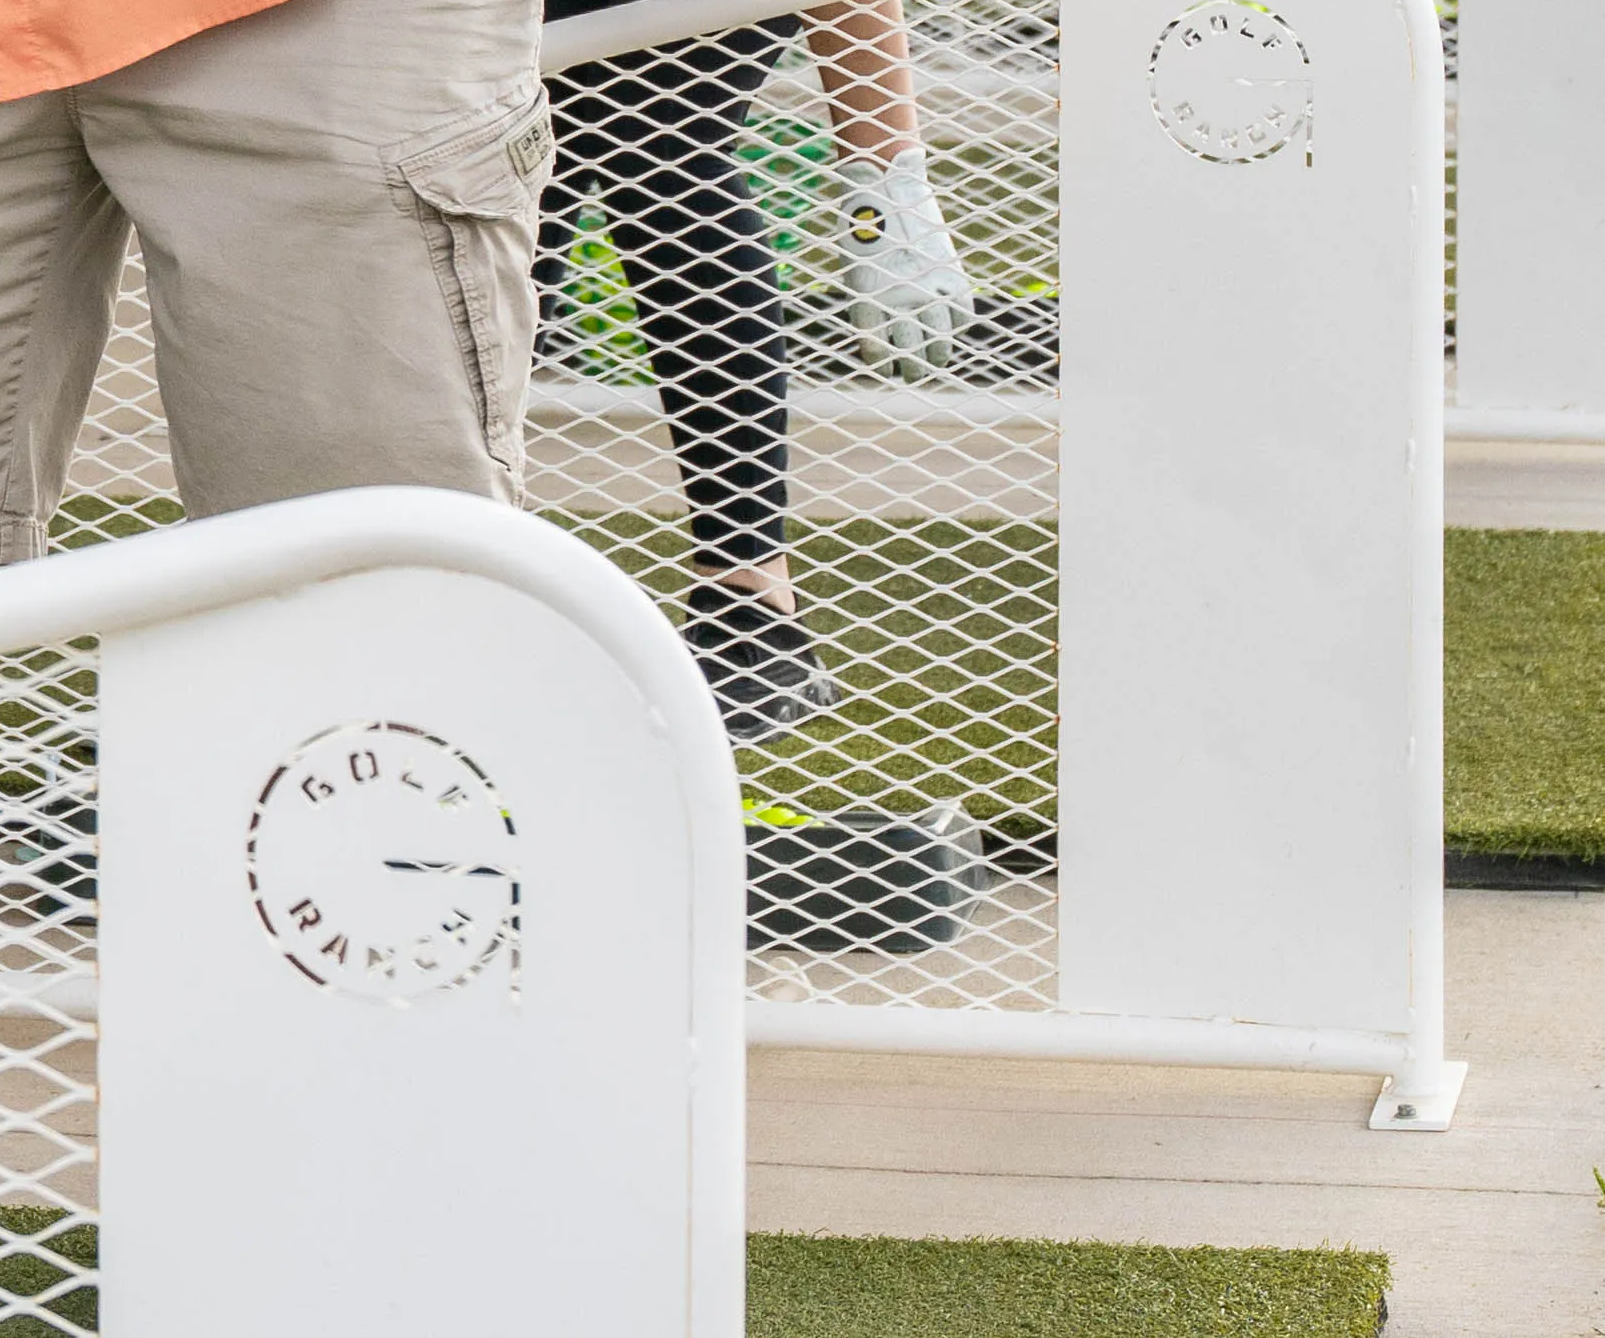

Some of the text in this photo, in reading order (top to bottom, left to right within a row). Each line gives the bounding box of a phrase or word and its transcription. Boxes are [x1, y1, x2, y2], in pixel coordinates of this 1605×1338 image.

[1182, 14, 1282, 49] GOLF
[1171, 100, 1286, 149] RANCH
[301, 750, 469, 808] GOLF
[288, 897, 472, 980] RANCH
